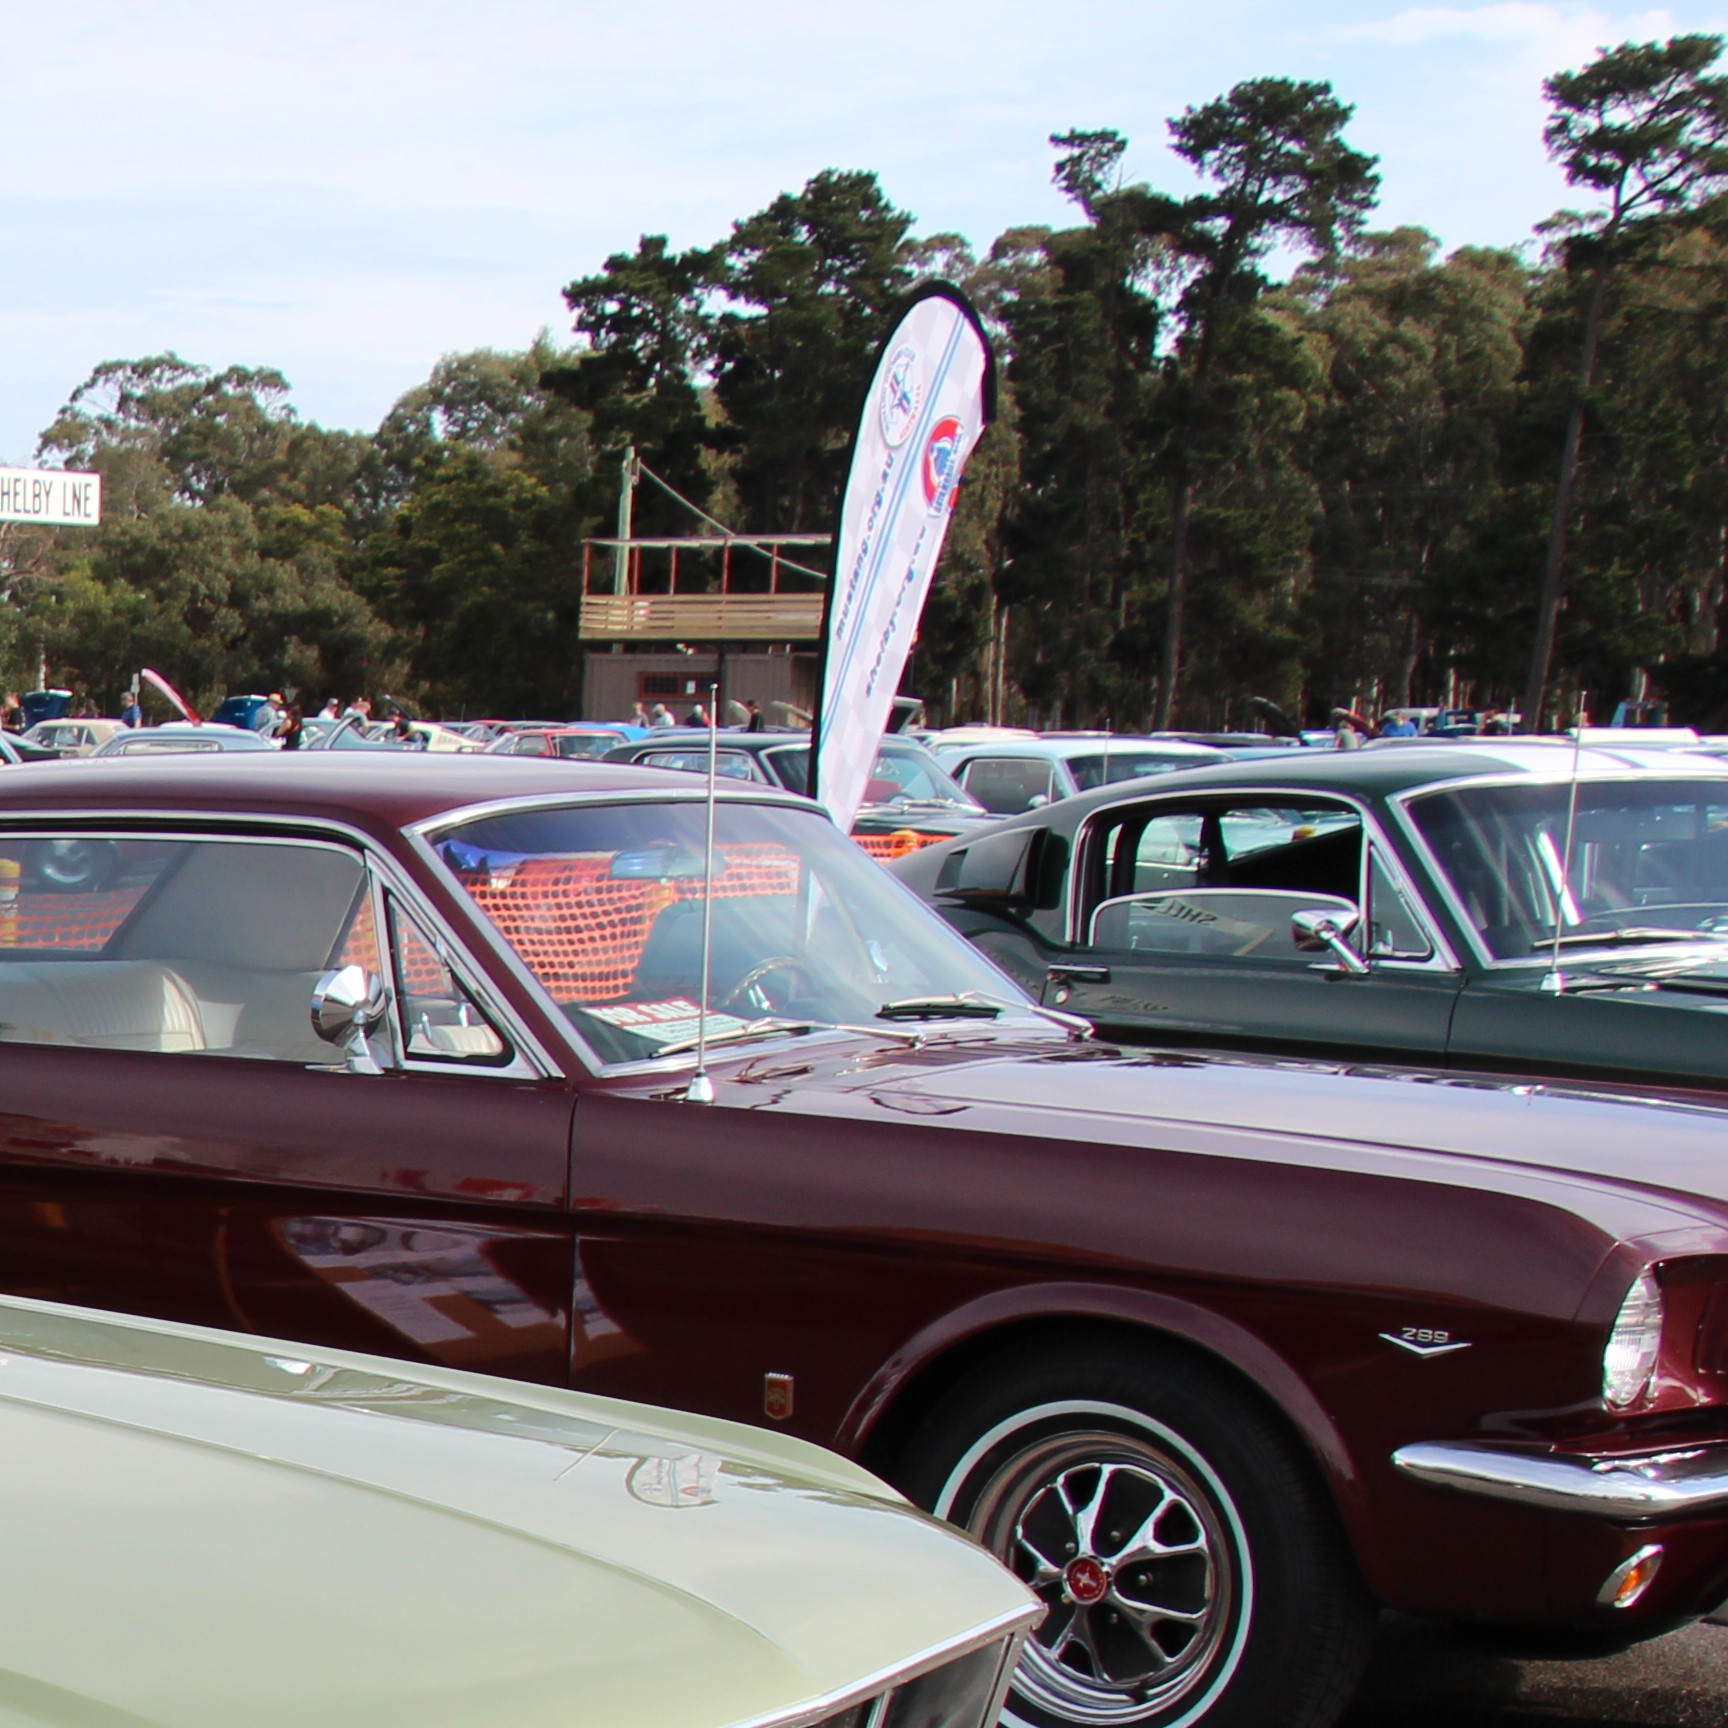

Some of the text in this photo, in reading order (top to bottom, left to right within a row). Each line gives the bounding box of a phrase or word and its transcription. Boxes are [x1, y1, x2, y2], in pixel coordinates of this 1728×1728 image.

[62, 481, 93, 518] LNE
[836, 451, 895, 641] mustang.org.au
[1401, 1327, 1449, 1343] 289
